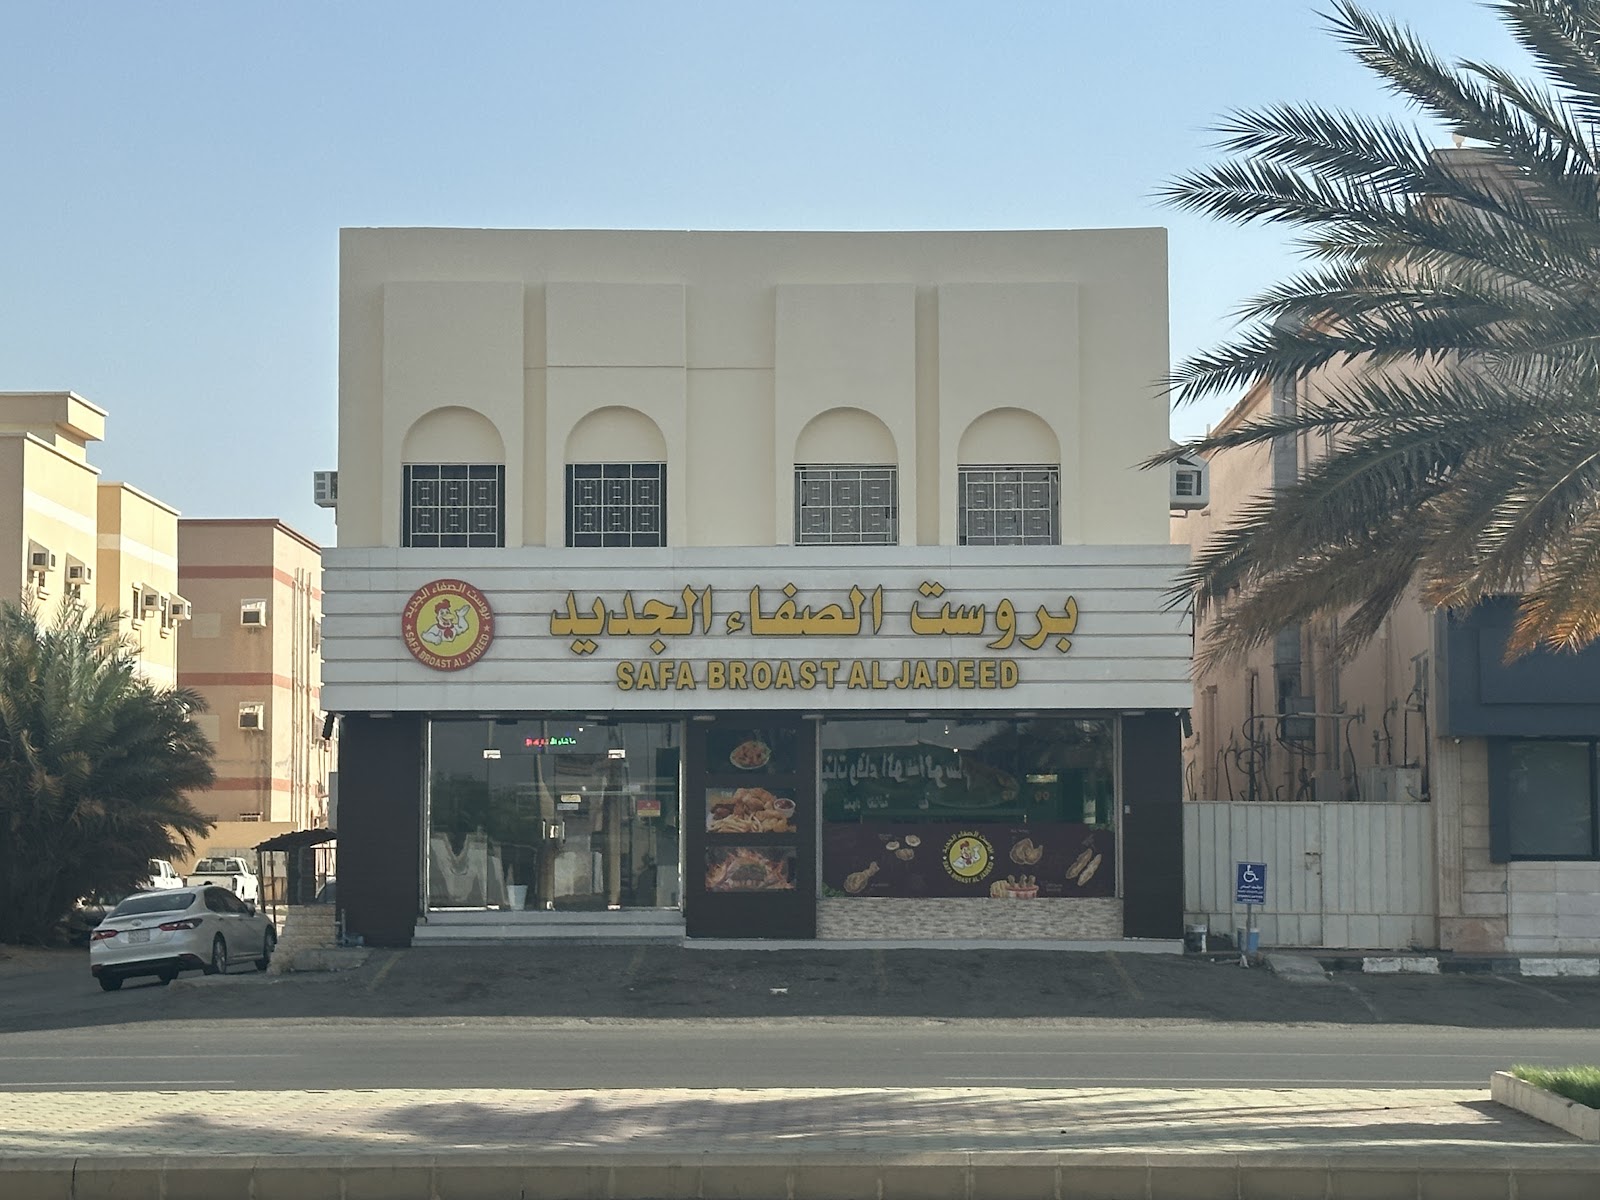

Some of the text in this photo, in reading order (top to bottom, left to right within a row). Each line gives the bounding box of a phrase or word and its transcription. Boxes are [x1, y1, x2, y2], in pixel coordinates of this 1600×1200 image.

[406, 582, 491, 620] بروست الصفاء الجديد
[550, 580, 1078, 655] بروست الصفاء الجديد
[406, 632, 490, 668] SAFA BROAST AL JADEED
[616, 660, 1019, 690] SAFA BROAST AL JADEED
